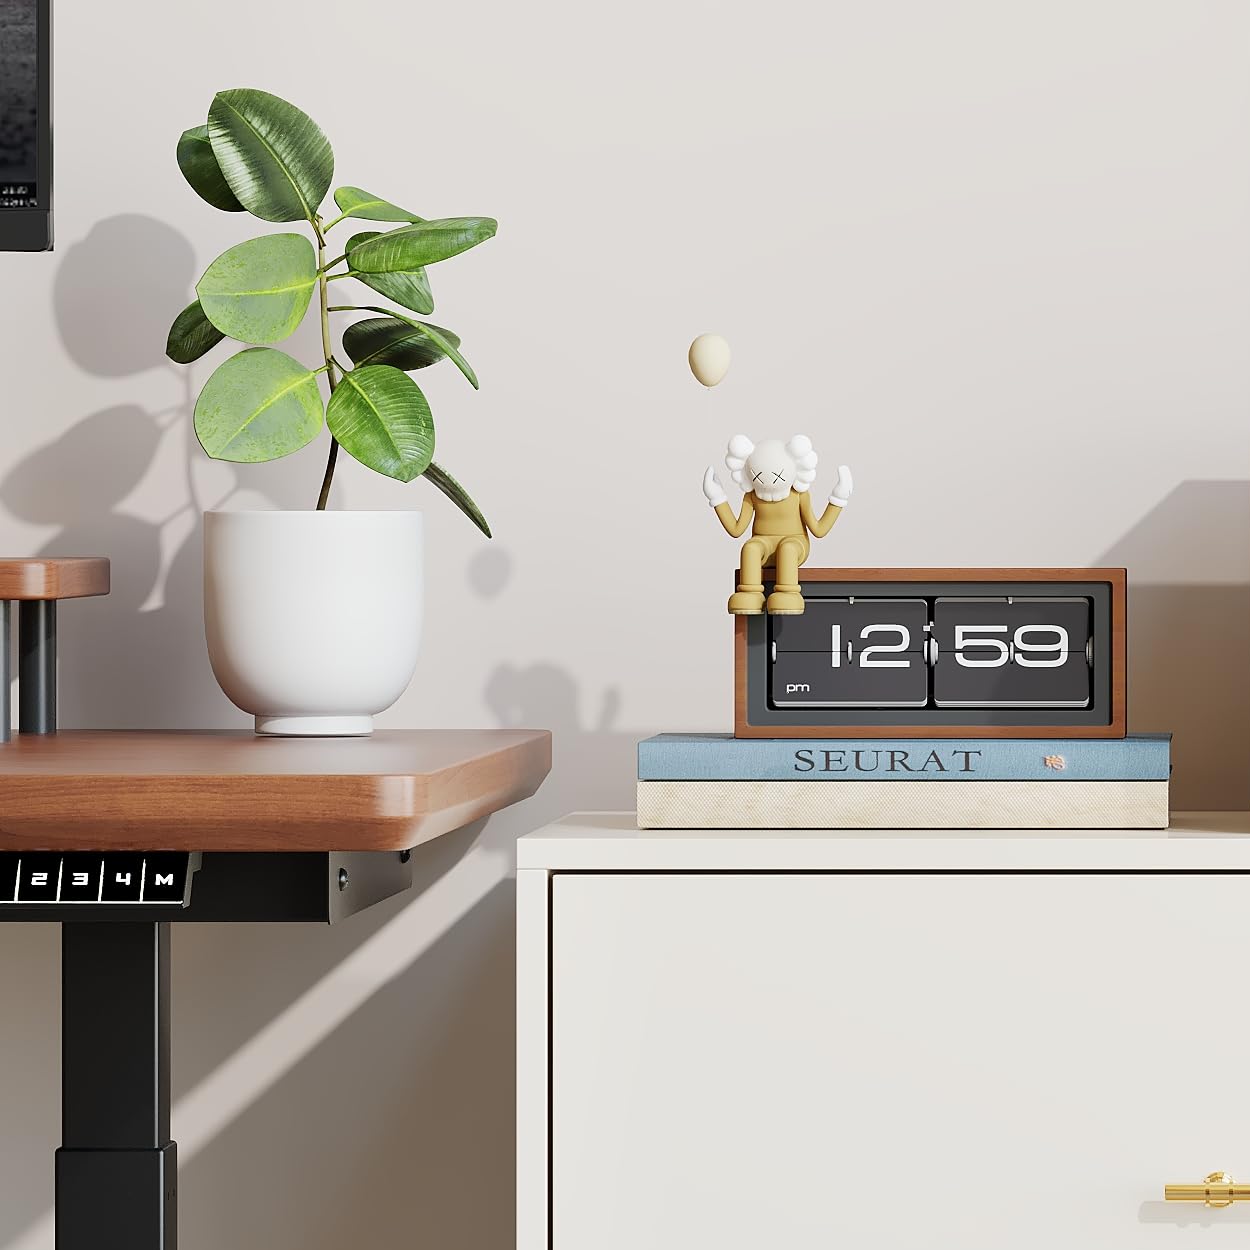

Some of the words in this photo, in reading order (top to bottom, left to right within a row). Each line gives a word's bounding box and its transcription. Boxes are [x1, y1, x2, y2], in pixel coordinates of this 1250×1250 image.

[954, 624, 1069, 668] 59
[786, 683, 810, 695] pm
[793, 749, 982, 773] SEURAT
[31, 872, 48, 886] 2
[71, 872, 89, 886] 3
[115, 872, 131, 886] 4
[154, 873, 174, 886] M
